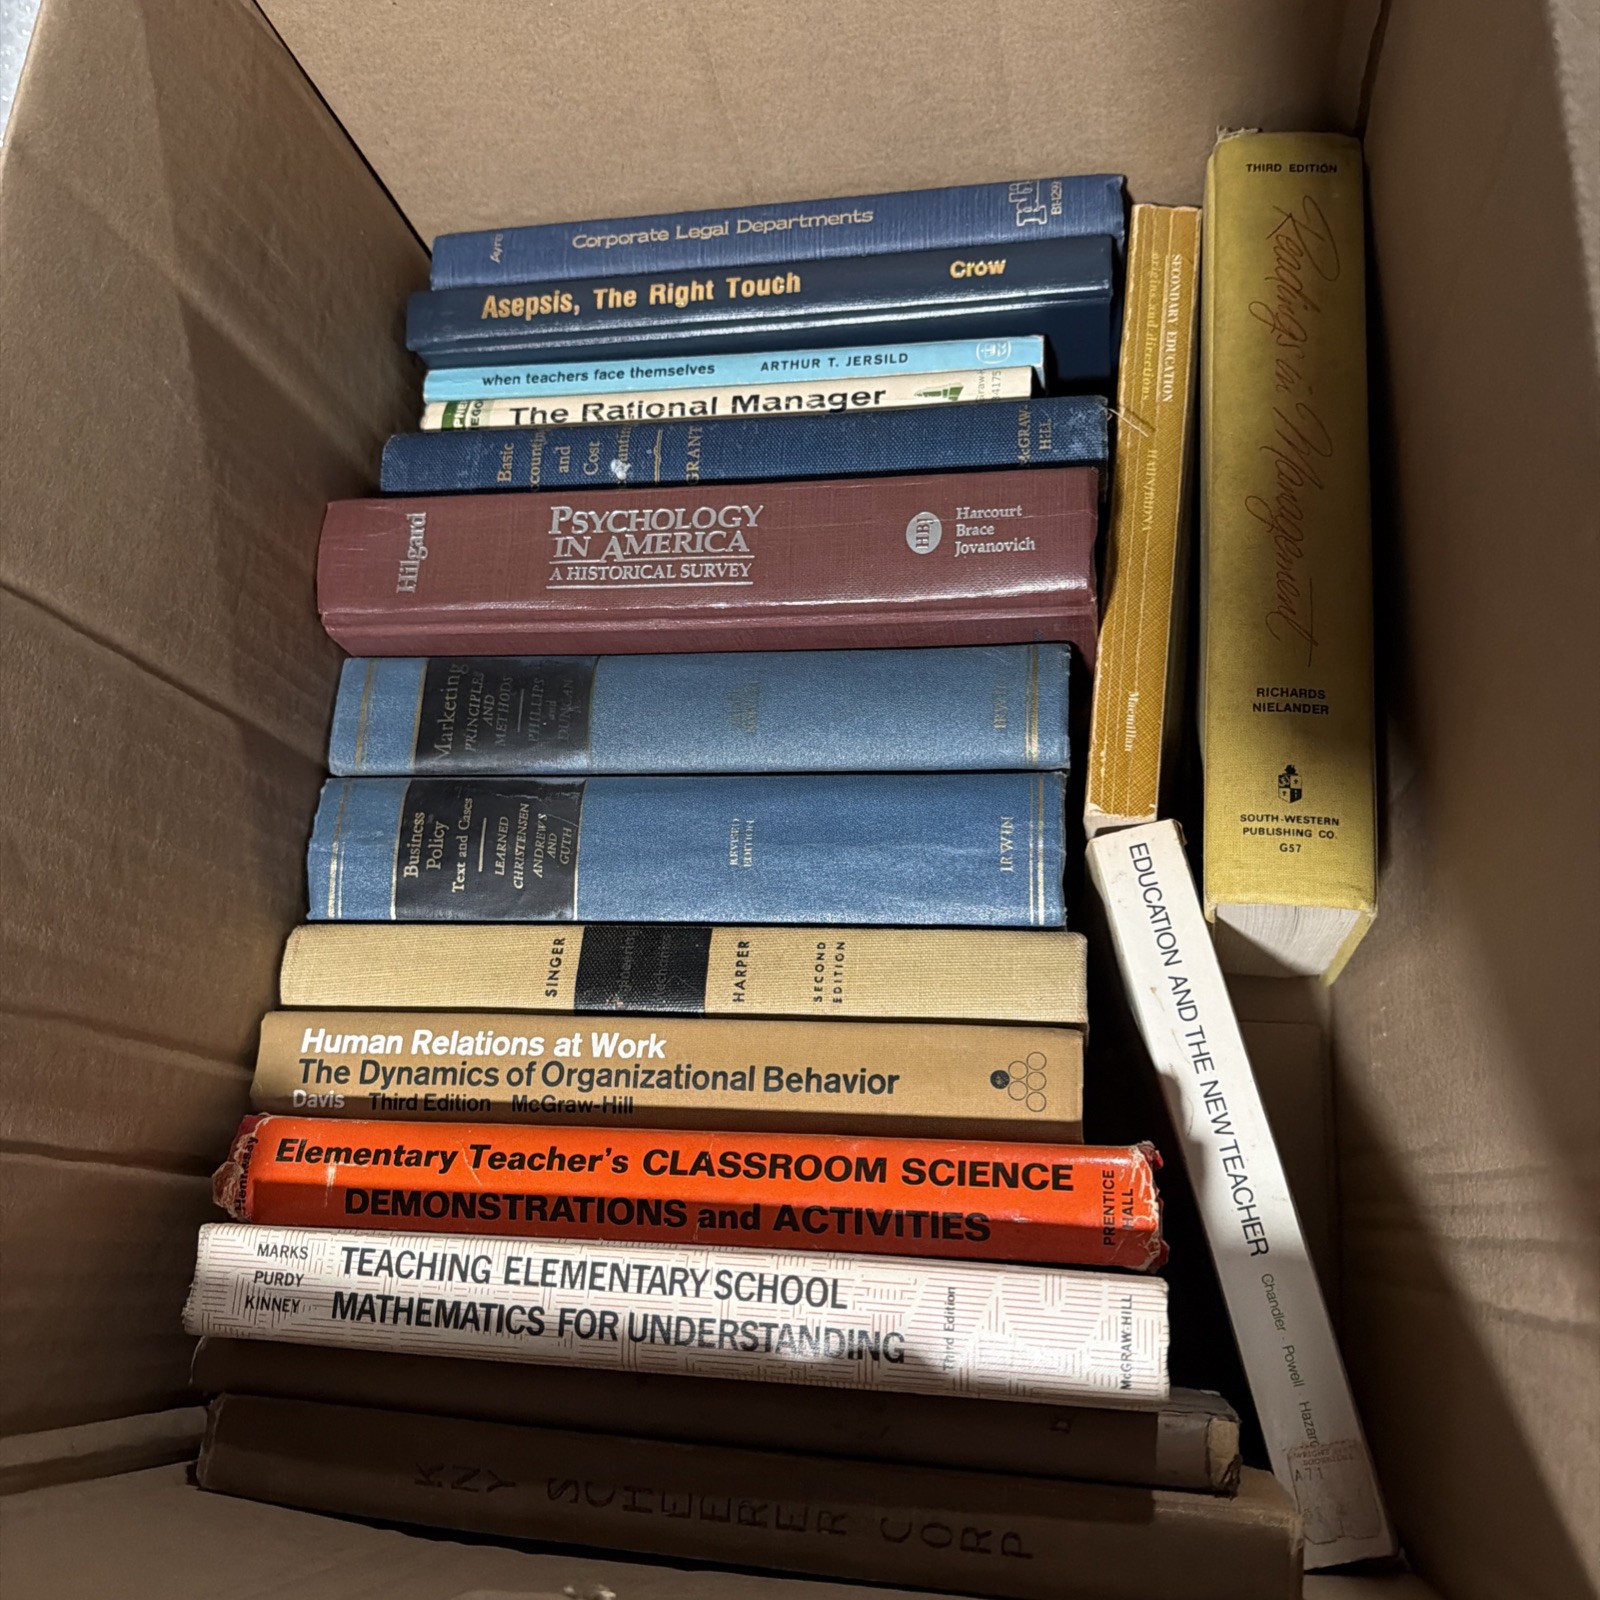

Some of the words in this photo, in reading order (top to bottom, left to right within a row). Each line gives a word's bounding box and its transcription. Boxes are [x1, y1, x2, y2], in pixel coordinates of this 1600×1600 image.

[1246, 163, 1282, 174] THIRD
[1289, 163, 1338, 174] EDITION
[572, 228, 670, 249] Corporate
[675, 221, 729, 242] Legal
[737, 208, 874, 236] Departments
[950, 259, 1006, 279] Crow
[1148, 252, 1160, 298] origins
[1166, 254, 1183, 325] SECONDARY
[1249, 195, 1340, 348] Readings
[481, 290, 581, 321] Asepsis,
[594, 286, 637, 310] The
[649, 280, 714, 308] Right
[726, 273, 801, 298] Touch
[1147, 304, 1158, 327] and
[482, 369, 521, 386] when
[525, 367, 589, 384] teachers
[594, 366, 625, 381] face
[630, 363, 715, 379] themselves
[760, 357, 821, 372] ARTHUR
[829, 356, 840, 369] T.
[846, 353, 909, 367] JERSILD
[1142, 333, 1157, 400] directions
[1162, 330, 1179, 402] EDUCATION
[1276, 358, 1313, 395] in
[510, 406, 569, 426] The
[582, 397, 718, 423] Rational
[731, 388, 887, 413] Manager
[498, 442, 515, 482] Basic
[558, 445, 571, 473] and
[583, 441, 600, 476] Cost
[686, 425, 703, 486] GRANT
[548, 504, 764, 534] PSYCHOLOGY
[915, 517, 934, 550] HBJ
[955, 504, 1022, 521] Harcourt
[955, 523, 995, 537] Brace
[396, 511, 428, 595] Hilgard
[553, 536, 590, 558] IN
[600, 530, 750, 563] AMERICA
[954, 537, 1036, 558] Jovanovich
[1245, 402, 1333, 668] Management
[549, 566, 562, 581] A
[566, 564, 677, 581] HISTORICAL
[679, 562, 754, 579] SURVEY
[435, 662, 469, 763] Marketing
[465, 671, 485, 752] PRINCIPLES
[483, 693, 495, 727] AND
[494, 675, 513, 749] METHODS
[528, 677, 545, 744] PHILLIPS
[1252, 702, 1330, 715] NIELANDER
[1256, 687, 1326, 700] RICHARDS
[1125, 691, 1139, 751] Macmillan
[458, 797, 473, 833] Cases
[1240, 813, 1340, 827] SOUTH-WESTERN
[1242, 827, 1313, 839] PUBLISHING
[1318, 829, 1338, 840] CO.
[404, 811, 425, 878] Business
[426, 820, 449, 870] Policy
[459, 836, 469, 859] and
[494, 815, 509, 876] LEARNED
[513, 802, 530, 890] CHRISTENSEN
[532, 812, 548, 878] ANDREWS
[547, 832, 558, 859] AND
[560, 826, 573, 866] GUTH
[743, 819, 754, 868] EDITION
[1000, 815, 1014, 873] IRWIN
[1279, 842, 1302, 854] G57
[452, 862, 466, 893] Text
[1128, 842, 1183, 969] EDUCATION
[545, 937, 566, 997] SINGER
[733, 940, 750, 1003] HARPER
[814, 942, 826, 1003] SECOND
[833, 941, 845, 1003] EDITION
[1168, 975, 1201, 1024] AND
[301, 1028, 403, 1056] Human
[411, 1030, 544, 1057] Relations
[553, 1033, 582, 1058] at
[591, 1032, 667, 1060] Work
[1182, 1023, 1217, 1074] THE
[299, 1058, 351, 1085] The
[359, 1060, 499, 1091] Dynamics
[505, 1061, 536, 1087] of
[541, 1062, 755, 1094] Organizational
[763, 1065, 900, 1095] Behavior
[292, 1089, 345, 1110] Davis
[369, 1090, 417, 1112] Third
[422, 1092, 491, 1113] Edition
[511, 1094, 634, 1115] McGraw-Hill
[1200, 1079, 1235, 1138] NEW
[275, 1138, 459, 1175] Elementary
[467, 1144, 629, 1174] Teacher’s
[642, 1149, 888, 1184] CLASSROOM
[902, 1158, 1075, 1192] SCIENCE
[344, 1188, 687, 1228] DEMONSTRATIONS
[698, 1207, 760, 1230] and
[773, 1206, 991, 1243] ACTIVITIES
[1103, 1169, 1116, 1246] PRENTICE
[1123, 1188, 1135, 1230] HALL
[1220, 1137, 1270, 1259] TEACHER
[257, 1244, 309, 1261] MARKS
[253, 1271, 305, 1288] PURDY
[341, 1246, 493, 1286] TEACHING
[503, 1256, 711, 1298] ELEMENTARY
[713, 1270, 848, 1309] SCHOOL
[244, 1296, 301, 1314] KINNEY
[946, 1286, 956, 1332] Edition
[331, 1292, 545, 1336] MATHEMATICS
[558, 1307, 620, 1341] FOR
[628, 1312, 906, 1365] UNDERSTANDING
[1260, 1272, 1288, 1336] Chandler
[1283, 1343, 1305, 1389] Powell
[942, 1336, 956, 1372] Third
[880, 1517, 1034, 1560] CORP
